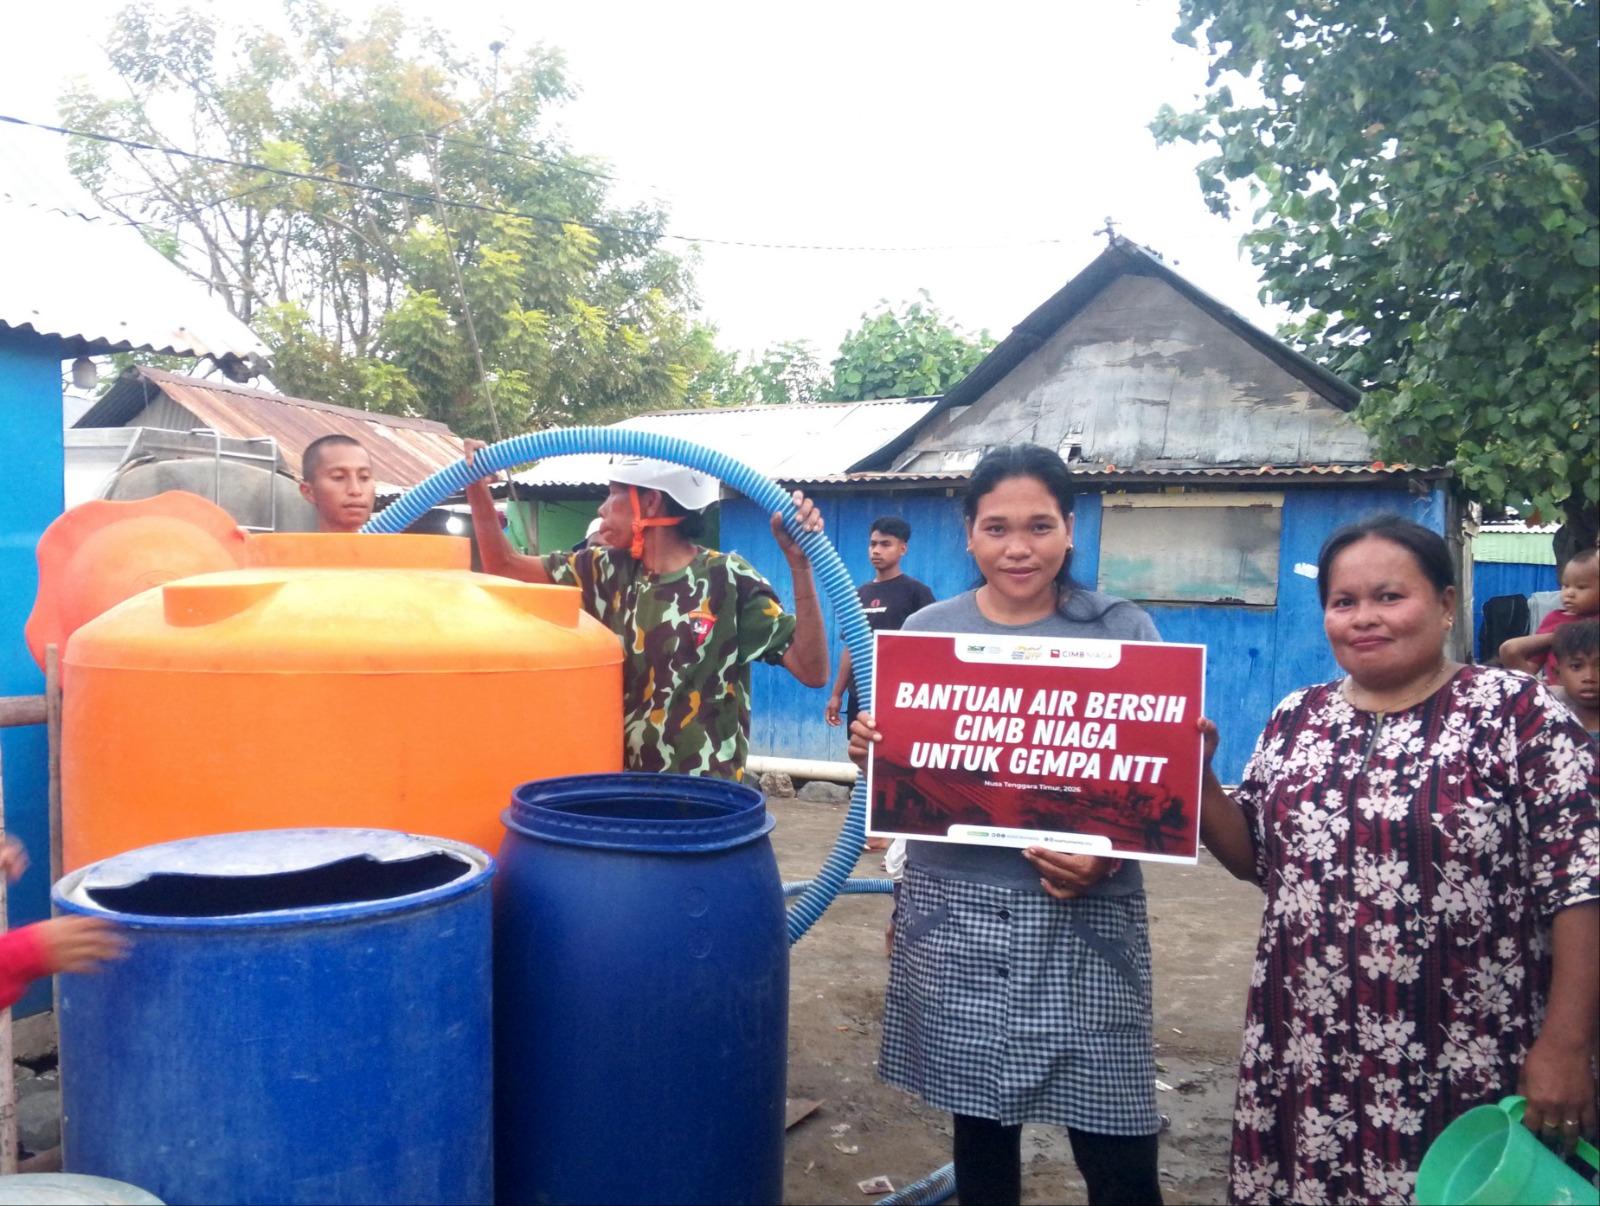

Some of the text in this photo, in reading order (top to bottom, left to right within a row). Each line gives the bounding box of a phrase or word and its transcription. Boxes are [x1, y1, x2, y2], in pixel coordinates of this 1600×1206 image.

[1062, 650, 1085, 658] CIMB
[895, 682, 1187, 724] BANTUAN AIR BERSIH
[954, 714, 1118, 750] CIMB NIAGA
[909, 741, 1169, 784] UNTUK GEMPA NTT
[984, 780, 1003, 788] Nusa
[1003, 781, 1038, 791] Tenggara
[1039, 784, 1063, 793] Timur,
